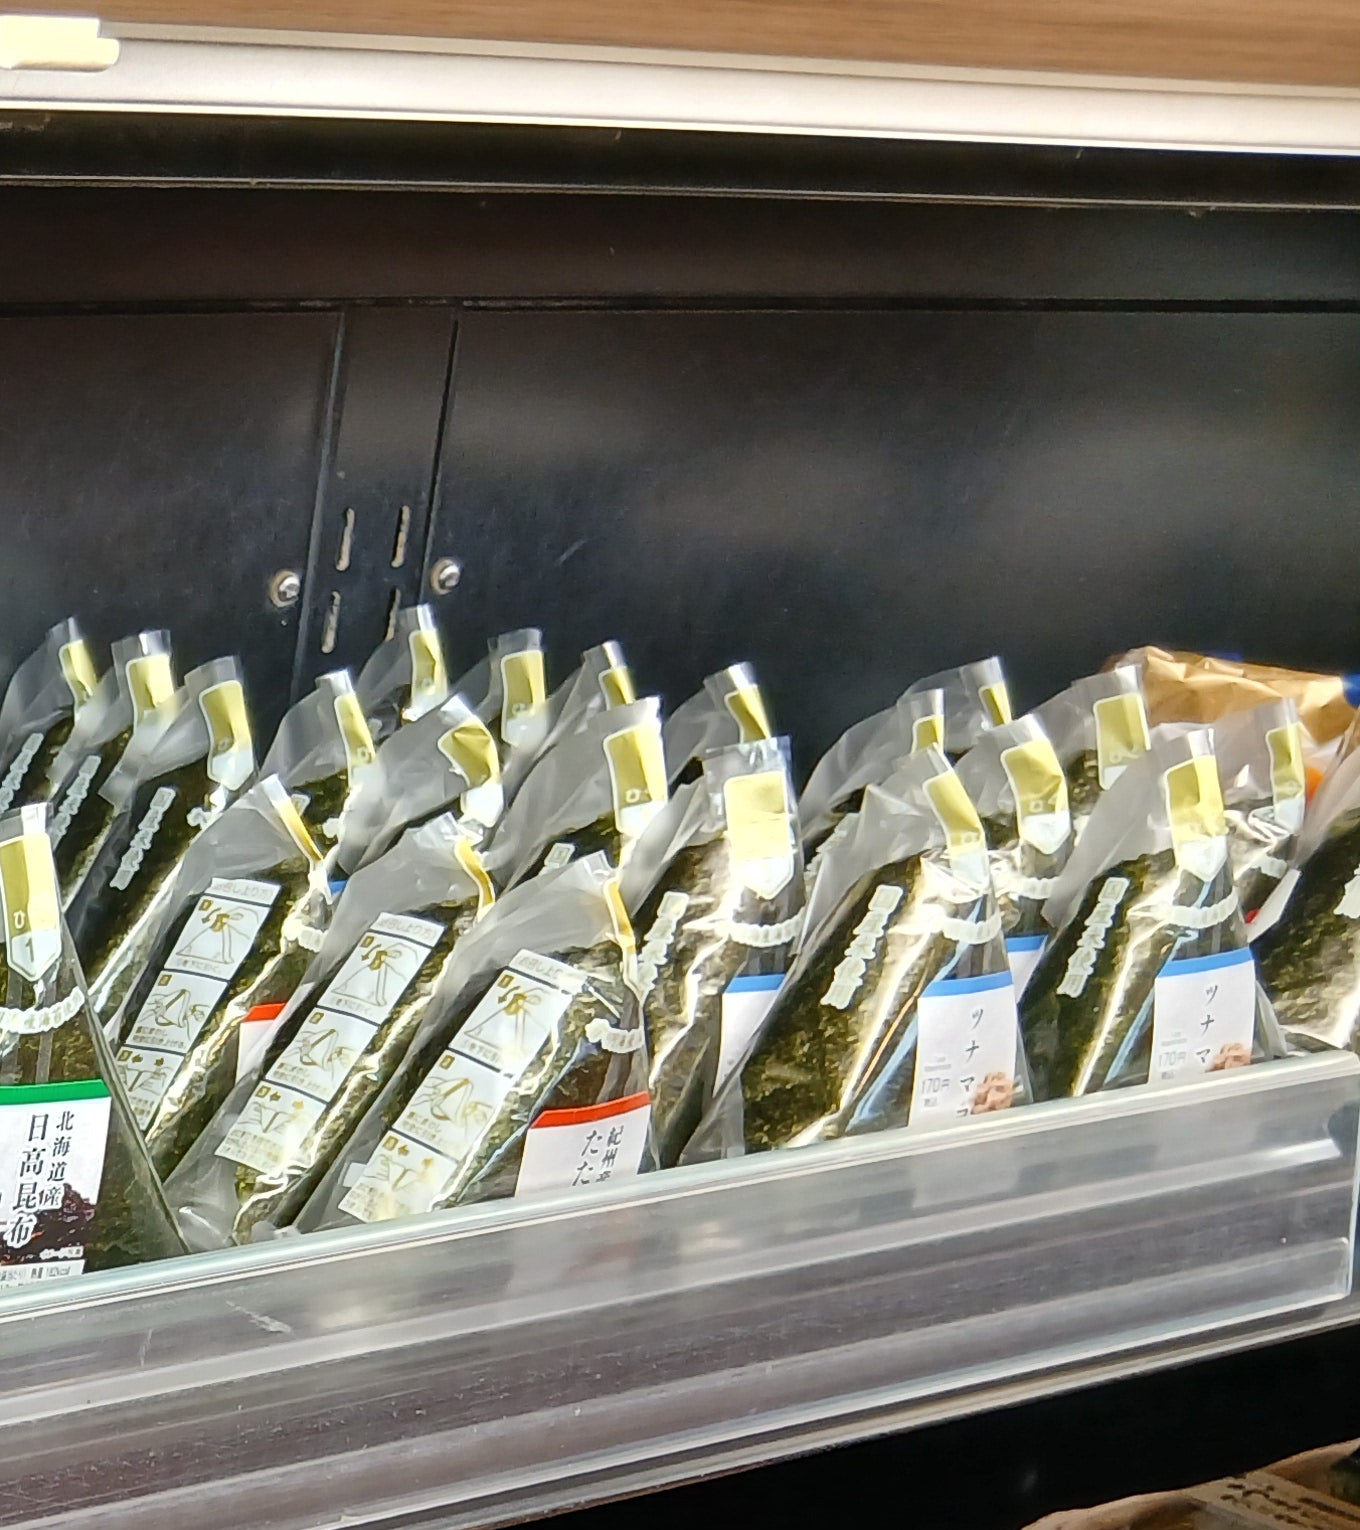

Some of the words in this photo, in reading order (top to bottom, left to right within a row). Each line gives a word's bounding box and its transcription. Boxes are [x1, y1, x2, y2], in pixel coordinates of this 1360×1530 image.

[10, 1113, 50, 1245] 日高昆布
[39, 1110, 76, 1207] 北海道産
[571, 1129, 603, 1187] たた
